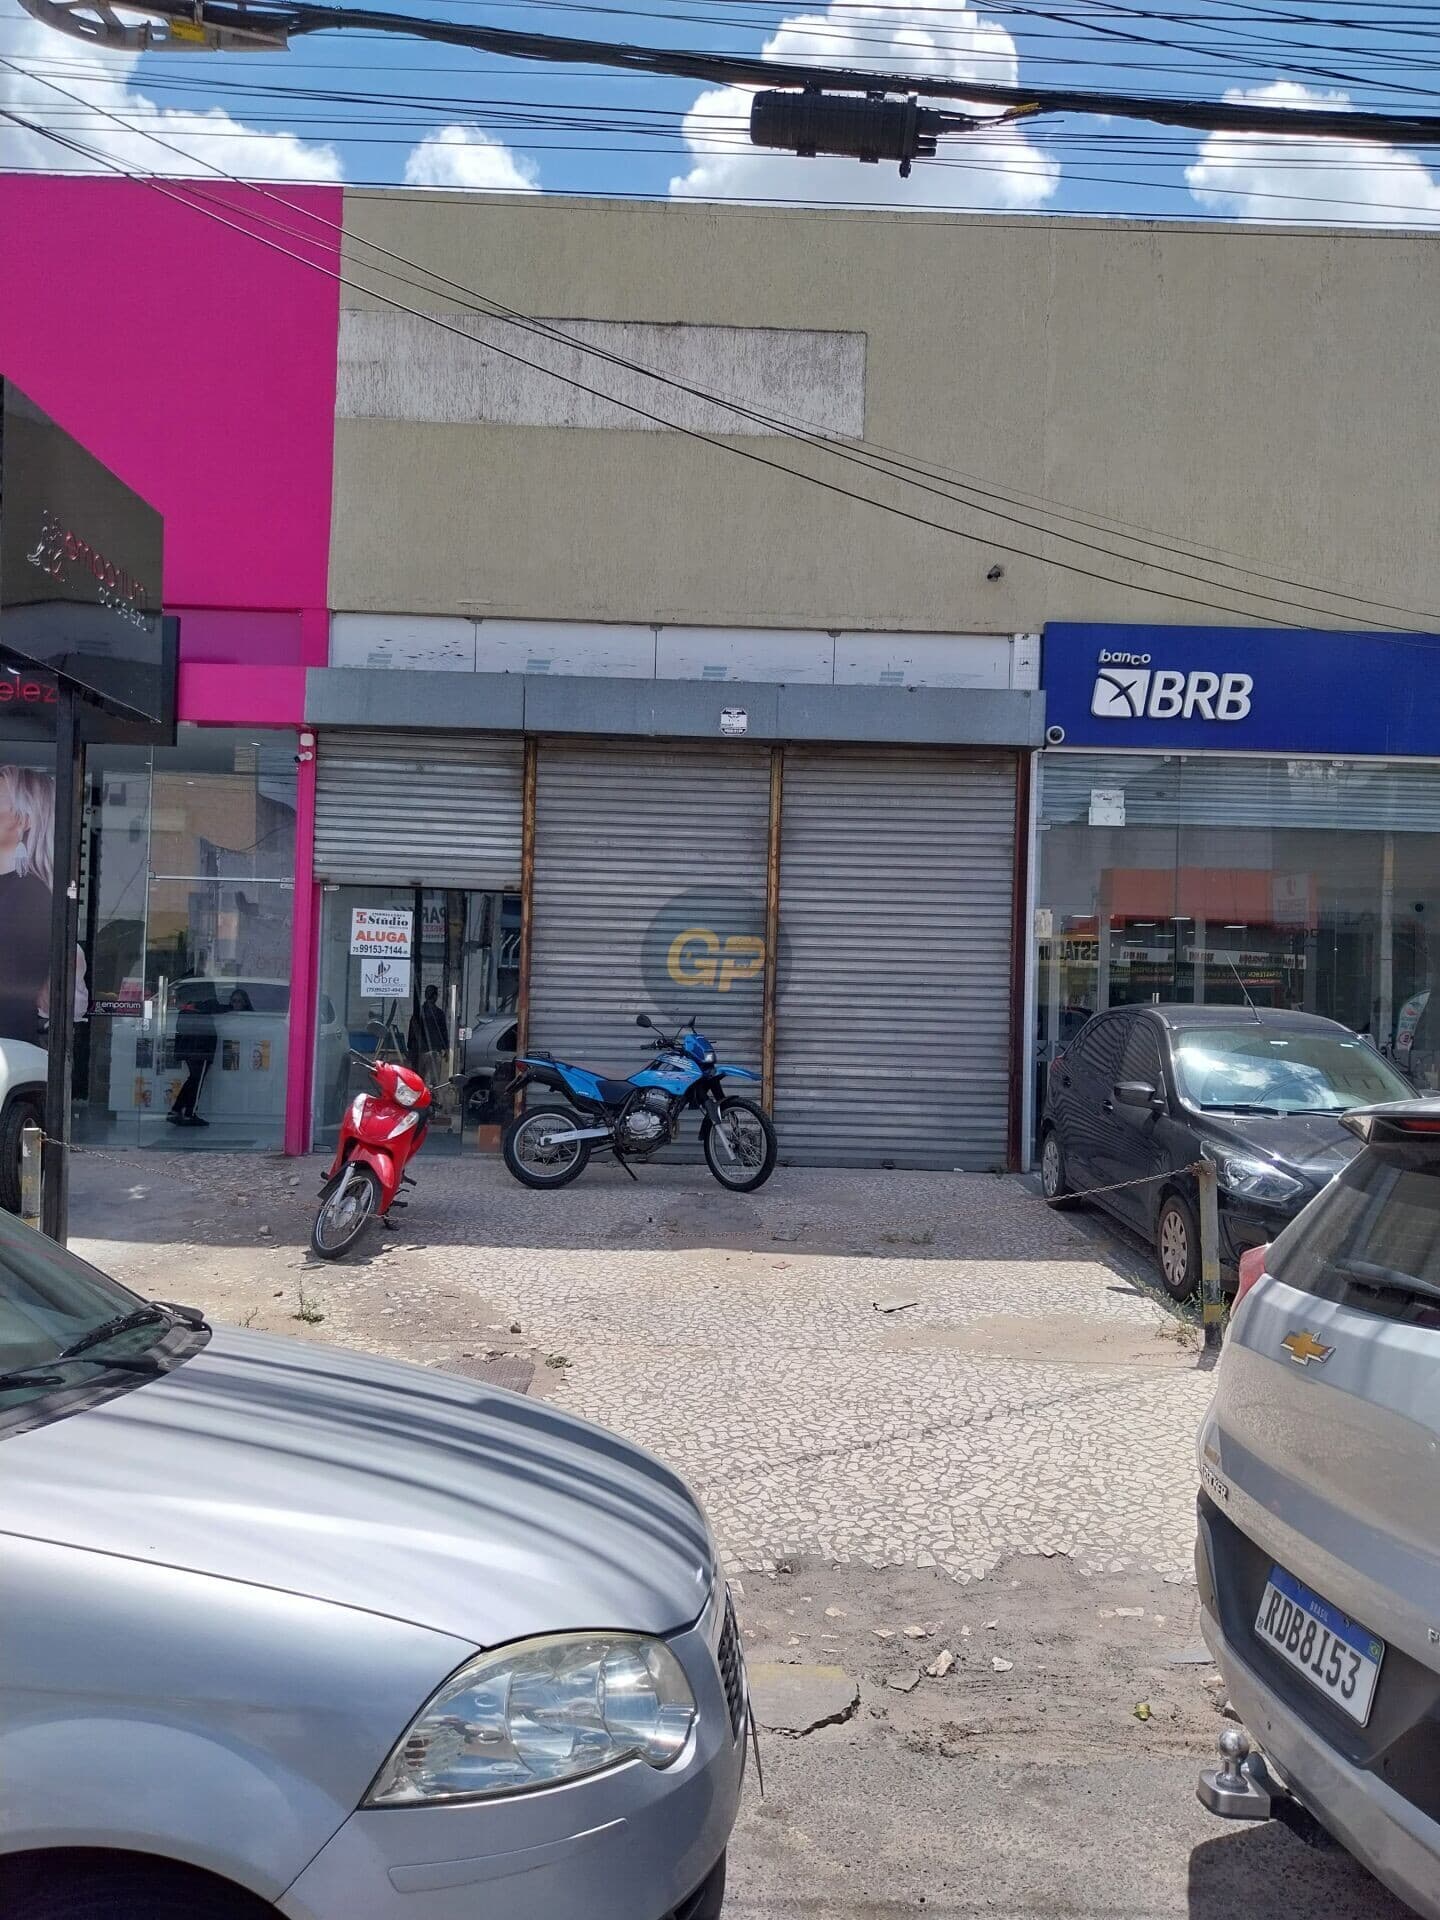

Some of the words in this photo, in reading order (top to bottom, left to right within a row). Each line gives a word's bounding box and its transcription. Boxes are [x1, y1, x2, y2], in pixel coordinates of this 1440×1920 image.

[1099, 649, 1151, 665] banco
[1149, 670, 1254, 720] BRB
[355, 930, 408, 943] ALUGA
[365, 973, 400, 984] Nobre
[1264, 1590, 1361, 1699] RDB8I53
